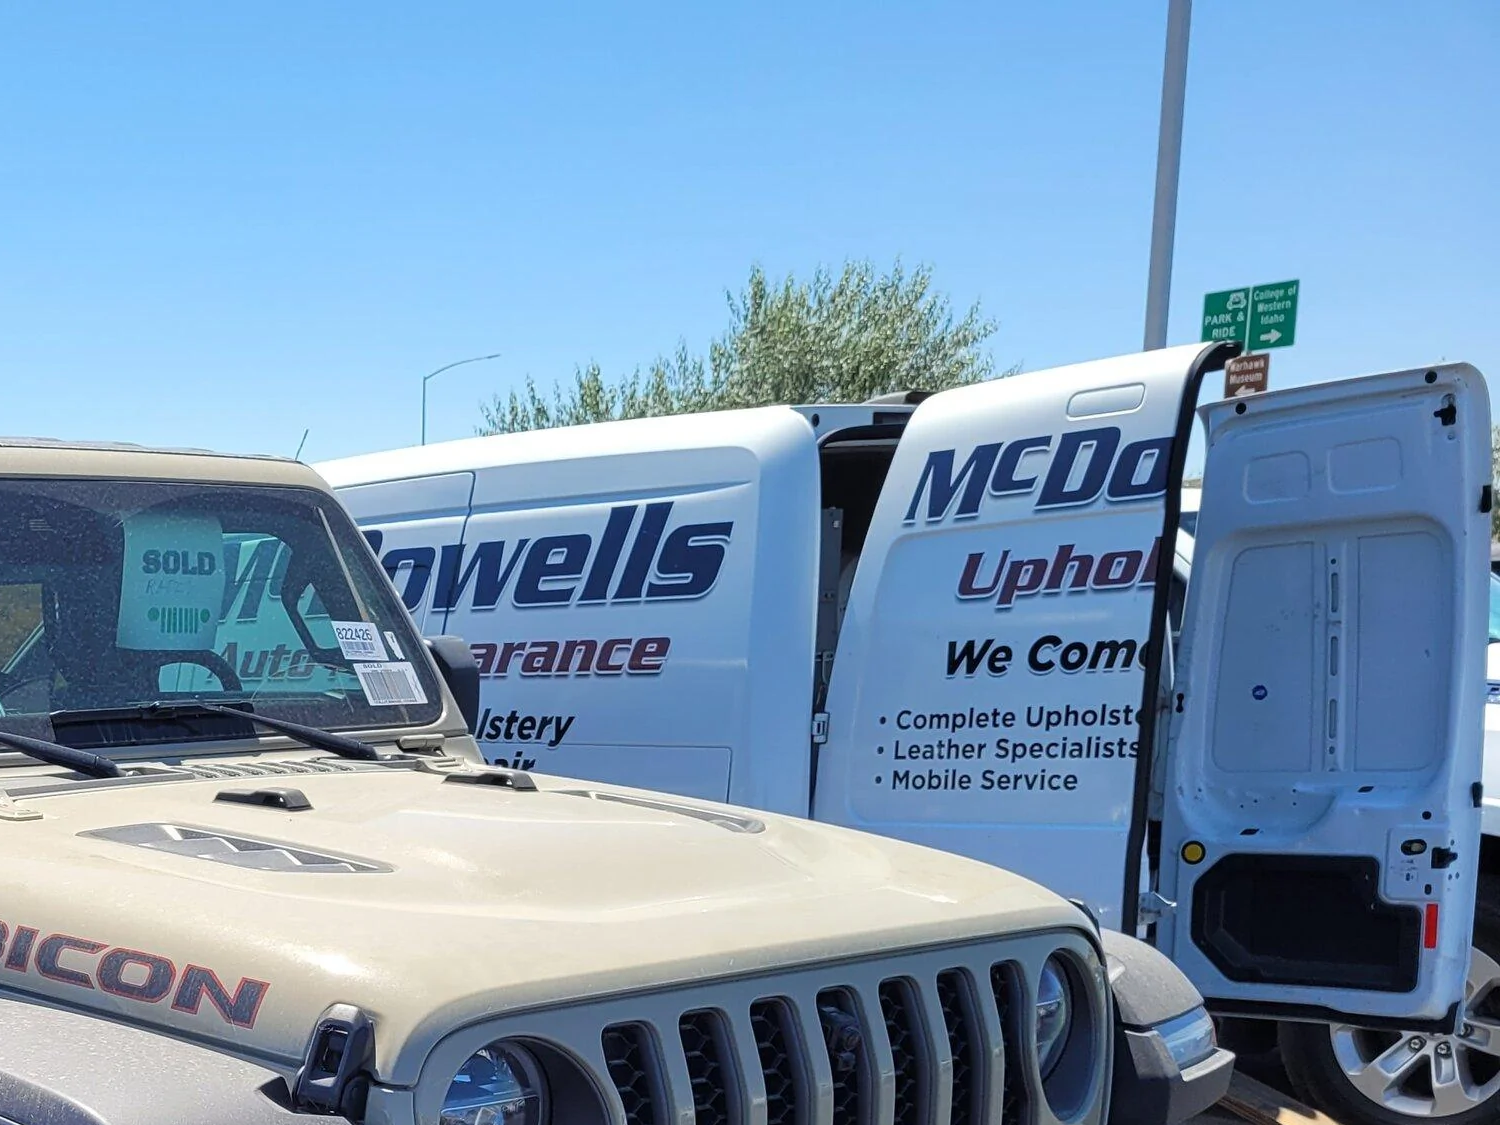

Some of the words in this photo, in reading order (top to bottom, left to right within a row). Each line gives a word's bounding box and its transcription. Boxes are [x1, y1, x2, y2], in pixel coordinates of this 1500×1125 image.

[1253, 289, 1286, 301] College
[1287, 285, 1297, 296] of
[1257, 300, 1292, 313] Western
[1204, 312, 1233, 326] PARK
[1236, 311, 1245, 322] &
[1260, 313, 1285, 326] Idaho
[1211, 326, 1236, 339] RIDE
[142, 549, 217, 576] SOLD
[335, 625, 373, 641] 822426
[946, 638, 1013, 677] We
[896, 707, 1016, 733] Complete
[894, 739, 987, 761] Leather
[995, 737, 1140, 763] Specialists
[891, 769, 972, 791] Mobile
[980, 769, 1079, 791] Service
